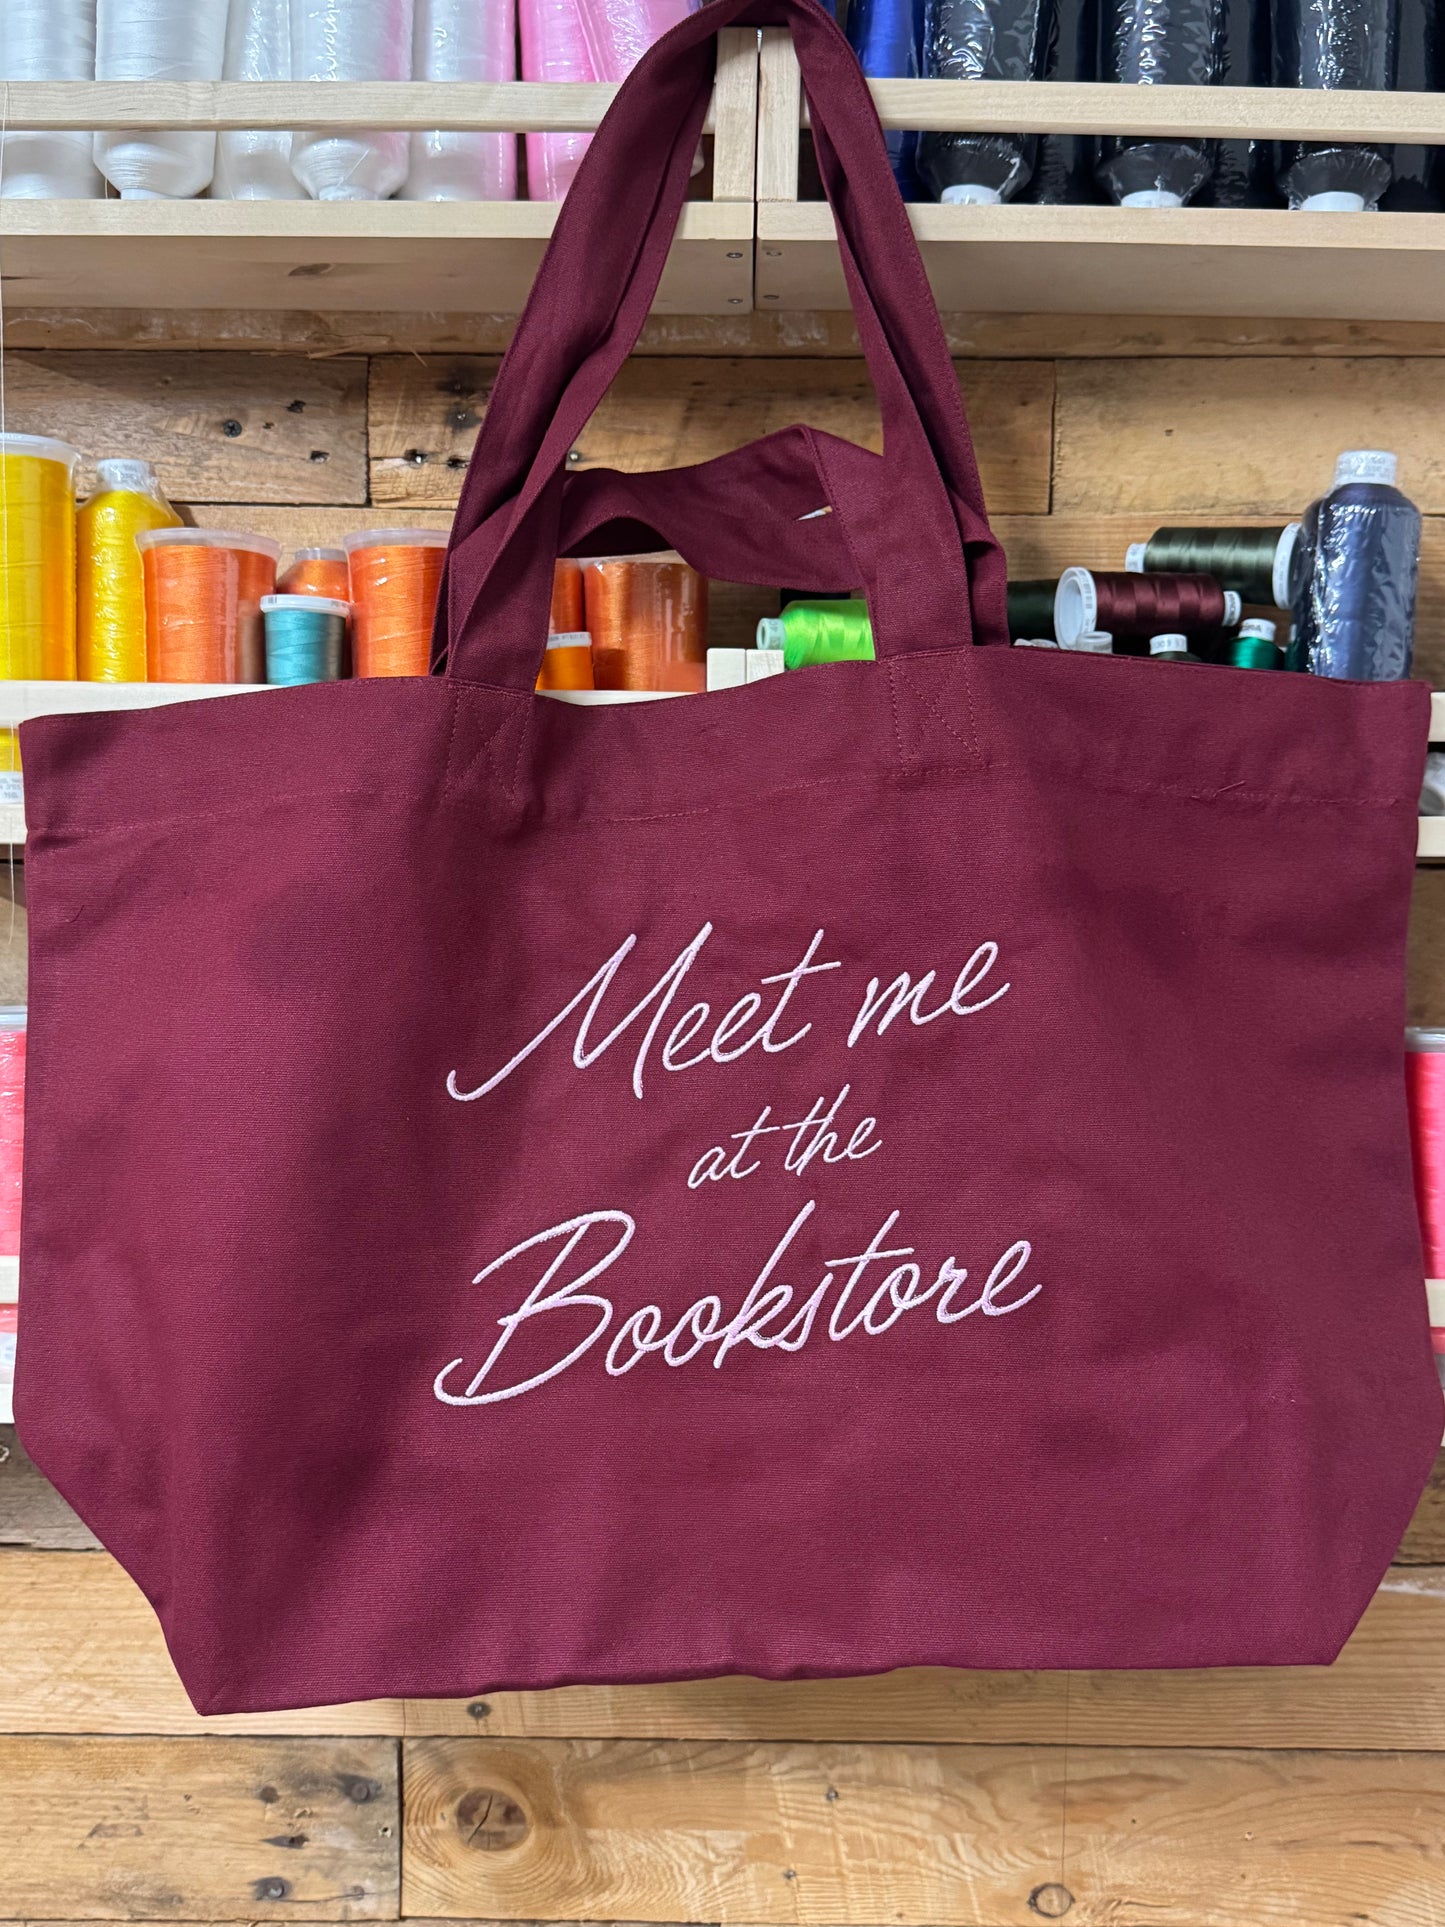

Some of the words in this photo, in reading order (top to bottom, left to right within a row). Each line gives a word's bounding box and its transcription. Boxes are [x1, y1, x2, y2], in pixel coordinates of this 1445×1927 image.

[446, 921, 842, 1102] Meet
[846, 941, 1011, 1048] me
[687, 1106, 780, 1190] at
[782, 1083, 883, 1177] the
[433, 1199, 1043, 1406] Bookstore
